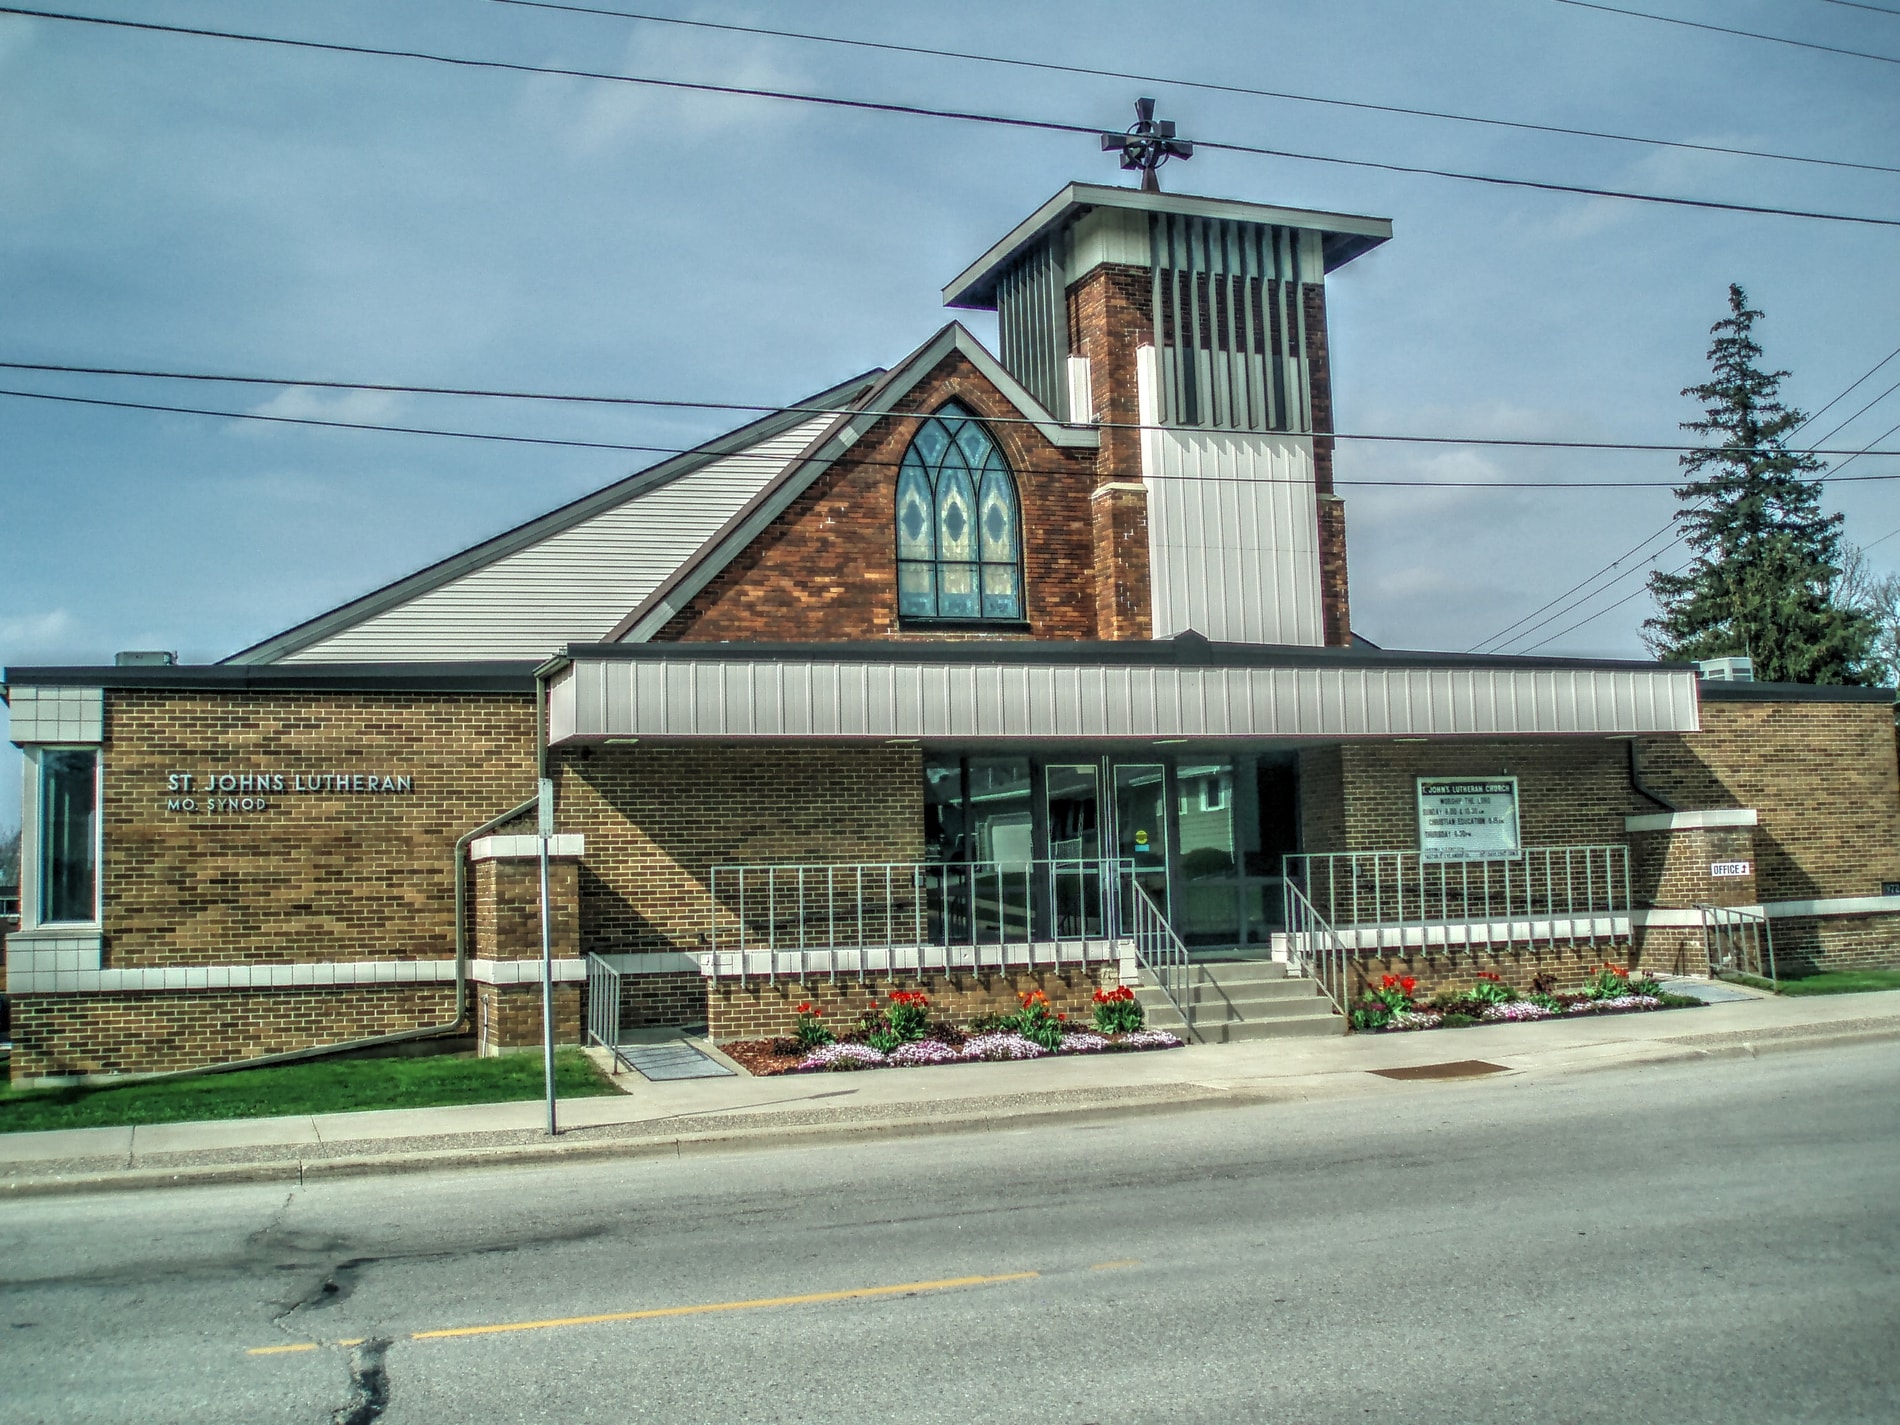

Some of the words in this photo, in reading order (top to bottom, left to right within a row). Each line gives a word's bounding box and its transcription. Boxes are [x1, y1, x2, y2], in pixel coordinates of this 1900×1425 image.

[168, 774, 196, 791] ST.
[204, 774, 284, 791] JOHNS
[295, 774, 412, 791] LUTHERAN
[1452, 785, 1483, 793] LUTHERAN
[167, 799, 198, 810] MO.
[207, 798, 266, 810] SYNOD
[1713, 864, 1740, 875] OFFICE
